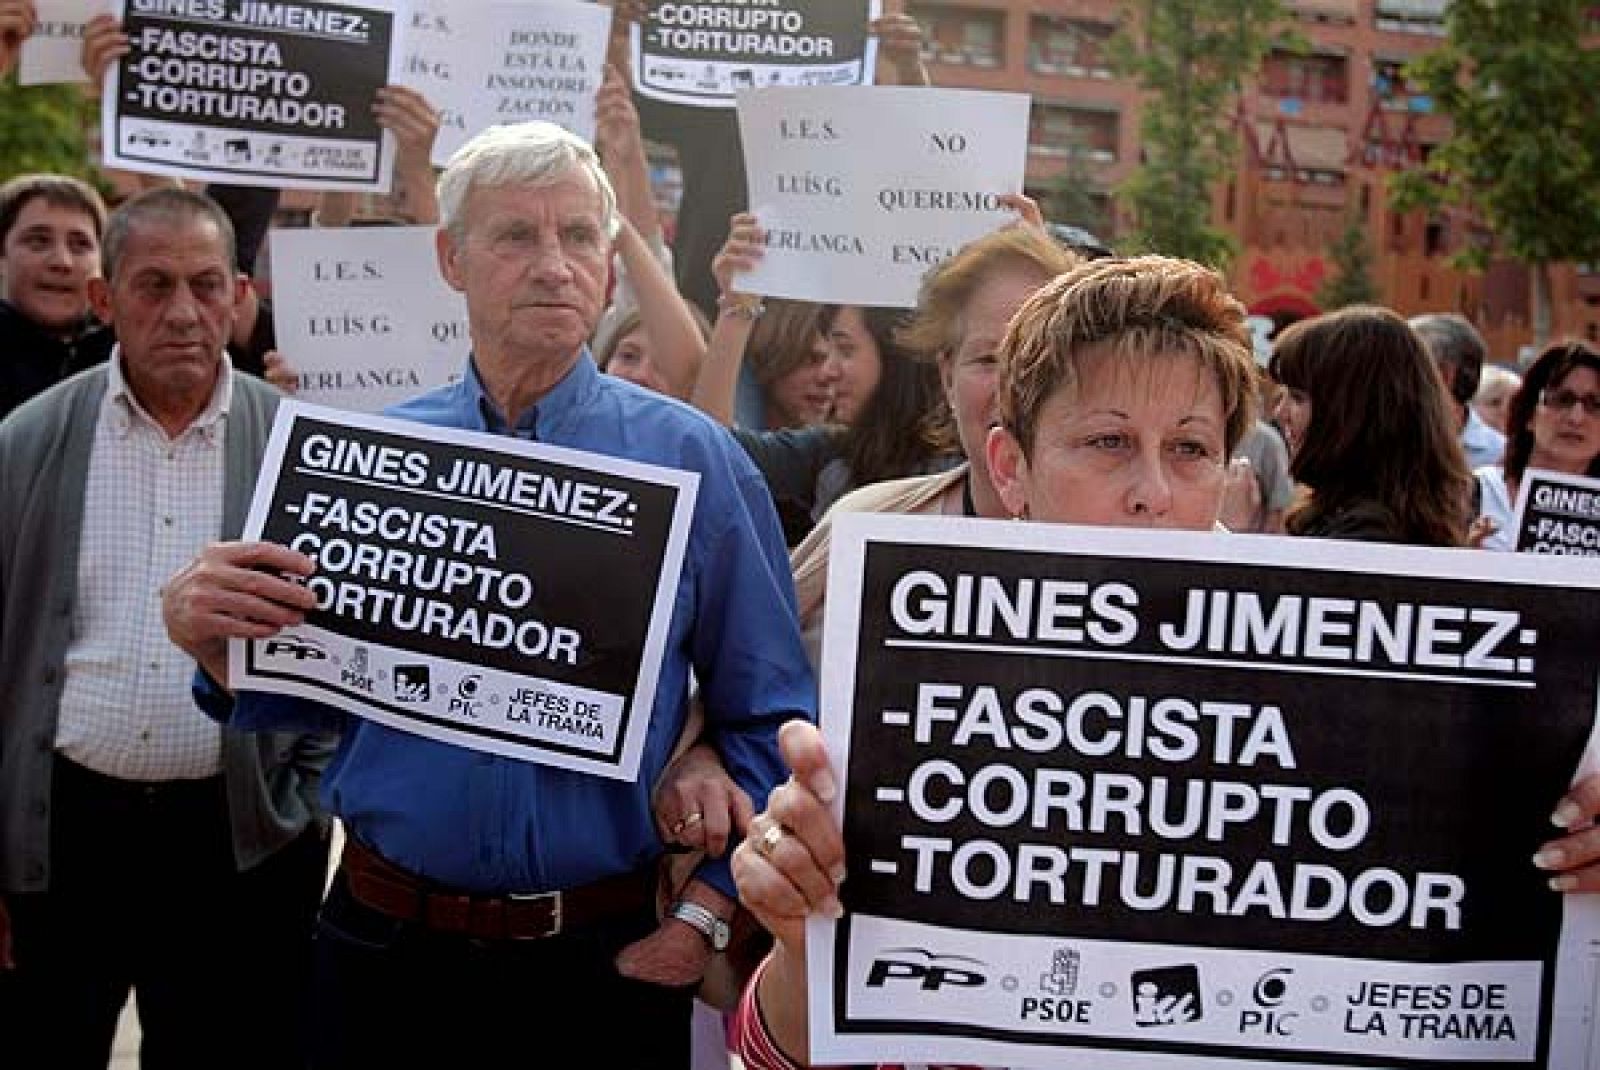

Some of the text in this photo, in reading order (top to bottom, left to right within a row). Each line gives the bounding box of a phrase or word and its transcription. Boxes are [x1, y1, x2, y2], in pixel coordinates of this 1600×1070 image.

[647, 3, 804, 33] -CORRUPTO
[128, 26, 283, 67] -FASCISTA
[647, 28, 833, 56] -TORTURADOR
[127, 55, 310, 97] -CORRUPTO
[124, 83, 345, 128] -TORTURADOR
[931, 133, 966, 153] NO
[879, 189, 1014, 211] QUEREMO
[765, 229, 865, 255] ERLANGA
[431, 321, 465, 342] QU
[303, 367, 420, 390] ERLANGA
[301, 434, 638, 527] GINES JIMENEZ:
[285, 492, 498, 561] -FASCISTA
[1528, 518, 1600, 548] -FASC
[889, 570, 1538, 673] GINES JIMENEZ:
[509, 688, 602, 720] JEFES DE
[507, 706, 605, 741] LA TRAMA
[881, 682, 1297, 771] -FASCISTA
[875, 759, 1371, 852] -CORRUPTO
[870, 837, 1467, 931] -TORTURADOR
[1020, 996, 1092, 1025] PSOE
[1347, 981, 1508, 1011] JEFES DE
[1238, 1010, 1298, 1038] PIC
[1344, 1009, 1517, 1041] LA TRAMA
